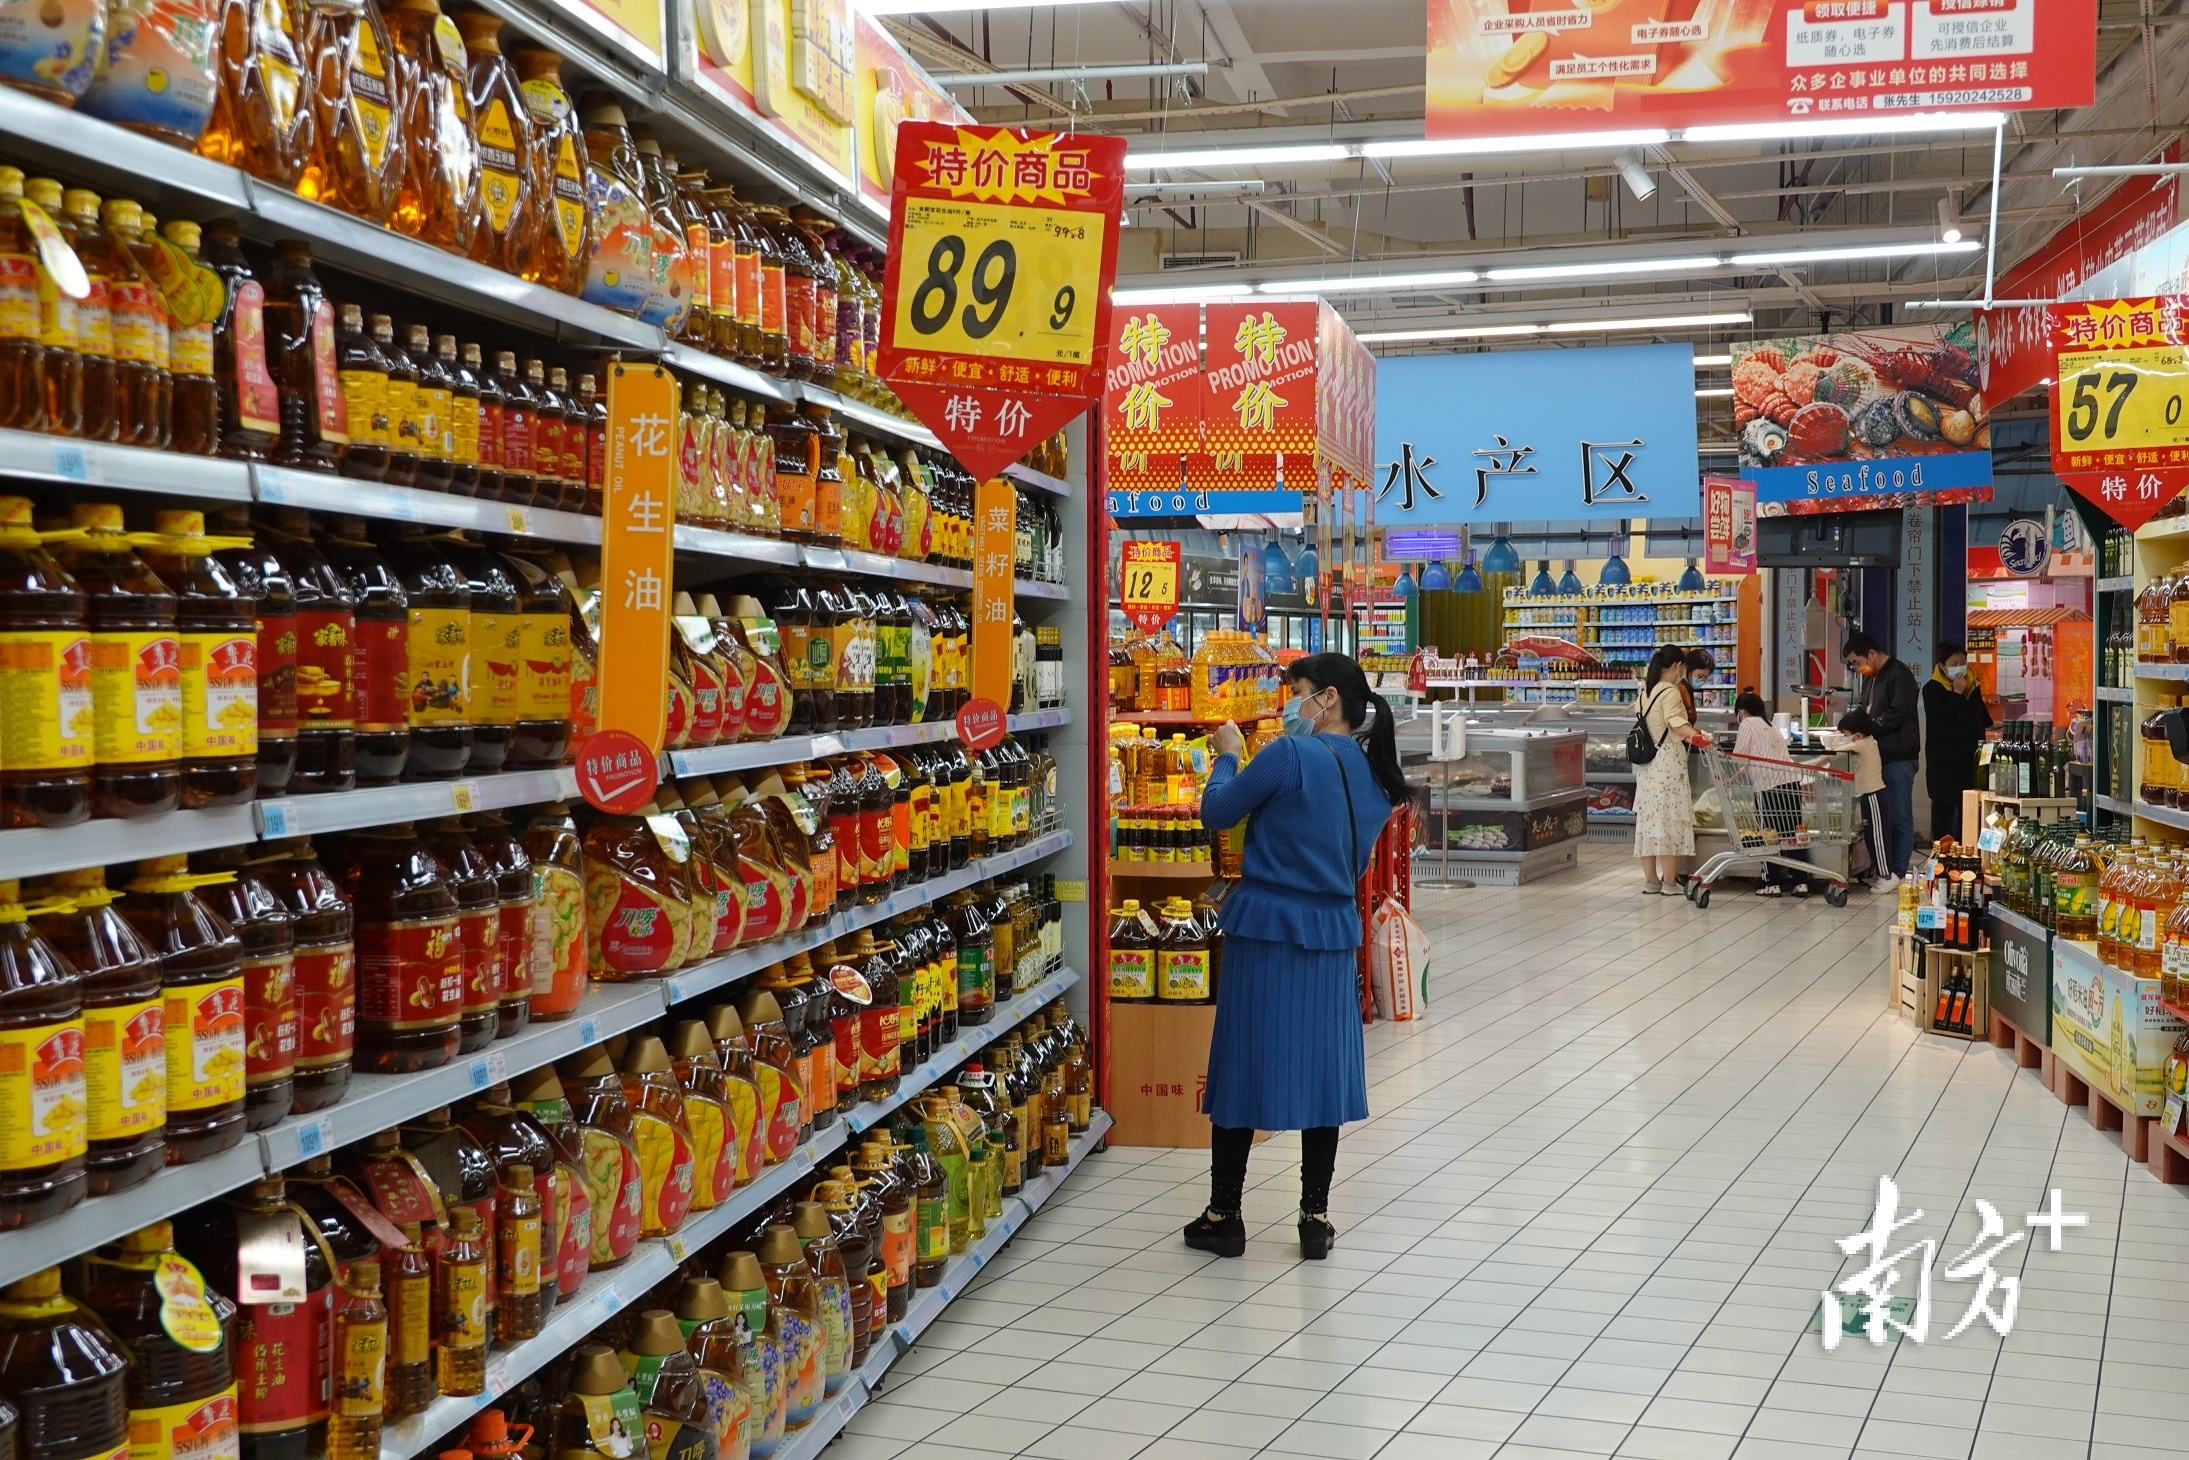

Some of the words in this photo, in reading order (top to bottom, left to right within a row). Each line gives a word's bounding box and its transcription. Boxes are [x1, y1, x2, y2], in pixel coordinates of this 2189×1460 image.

[1815, 1, 1877, 18] 领取便捷
[1483, 15, 1588, 31] 企业采购人员省时省力
[1637, 24, 1702, 39] 电子券随心选
[1938, 19, 2007, 35] 可授信企业
[1796, 26, 1895, 44] 纸质券，电子券
[1930, 35, 2014, 52] 先消费后结算
[1824, 43, 1866, 58] 随心选
[1555, 60, 1651, 75] 满足员工个性化需求
[1790, 62, 2028, 92] 众多企事业单位的共同选择
[1818, 96, 1868, 112] 联系电话
[1883, 94, 1921, 107] 张先生
[1929, 89, 2022, 105] 15920242528
[928, 146, 1090, 192] 特价商品
[2070, 310, 2185, 345] 特价商品
[1108, 338, 1198, 392] ROMOTION
[1119, 313, 1173, 433] 特价
[1233, 312, 1288, 433] 特价
[944, 394, 1033, 438] 特价
[614, 426, 625, 470] PEANUT
[1375, 434, 1649, 512] 水产区
[1807, 463, 1924, 495] Seafood
[613, 476, 624, 494] OIL
[2101, 474, 2163, 501] 特价
[624, 412, 670, 611] 花生油
[1131, 546, 1173, 558] 特价商品
[985, 506, 1010, 623] 菜籽油
[1138, 613, 1161, 625] 特价
[963, 709, 999, 728] 特价商品
[586, 749, 643, 775] 特价商品
[605, 768, 643, 781] PROMOTION
[631, 925, 655, 938] Knife
[1140, 1083, 1184, 1098] 中国味
[270, 1342, 286, 1388] 花生油
